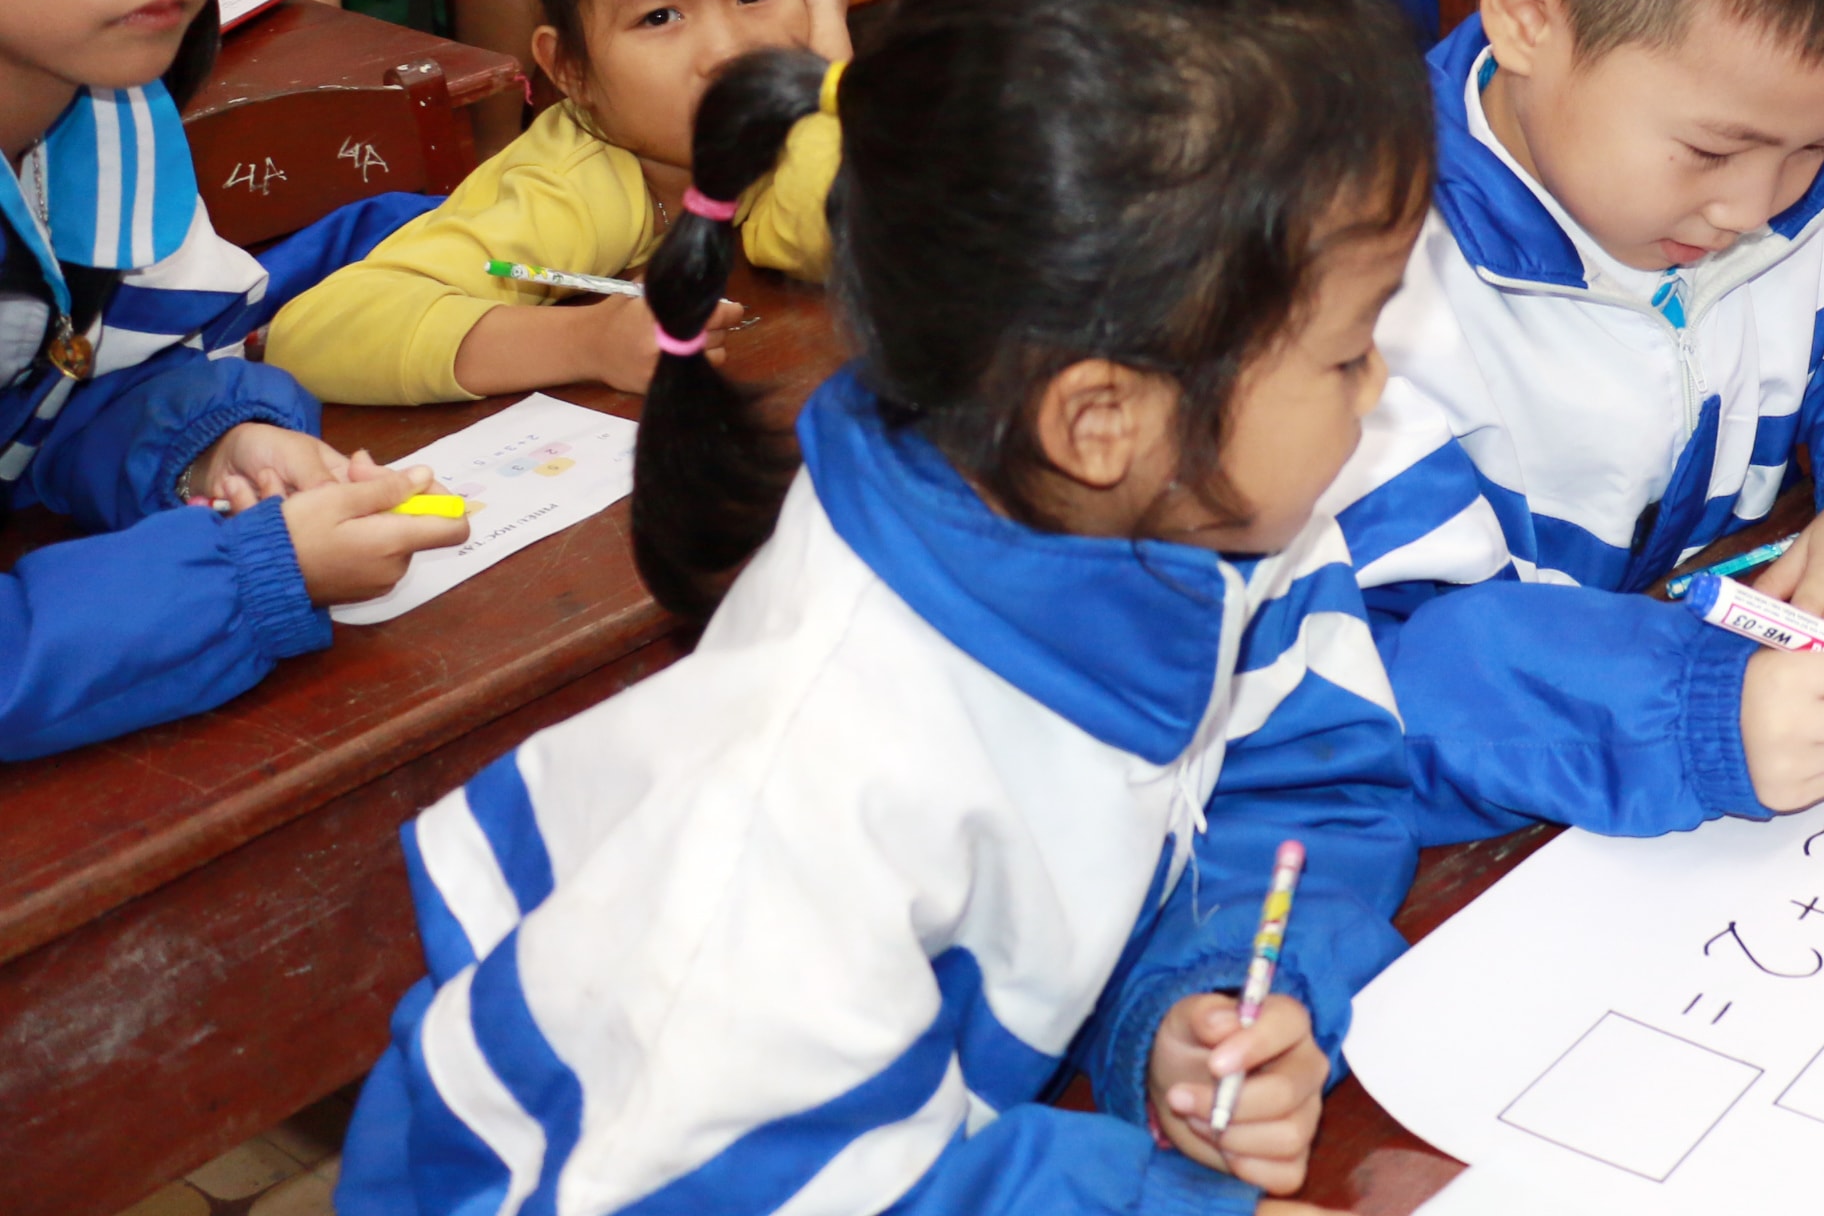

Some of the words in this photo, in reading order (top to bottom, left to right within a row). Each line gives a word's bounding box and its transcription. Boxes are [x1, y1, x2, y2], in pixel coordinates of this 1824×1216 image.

[222, 157, 288, 195] 4A
[337, 136, 390, 183] 4A
[1704, 921, 1823, 979] 2
